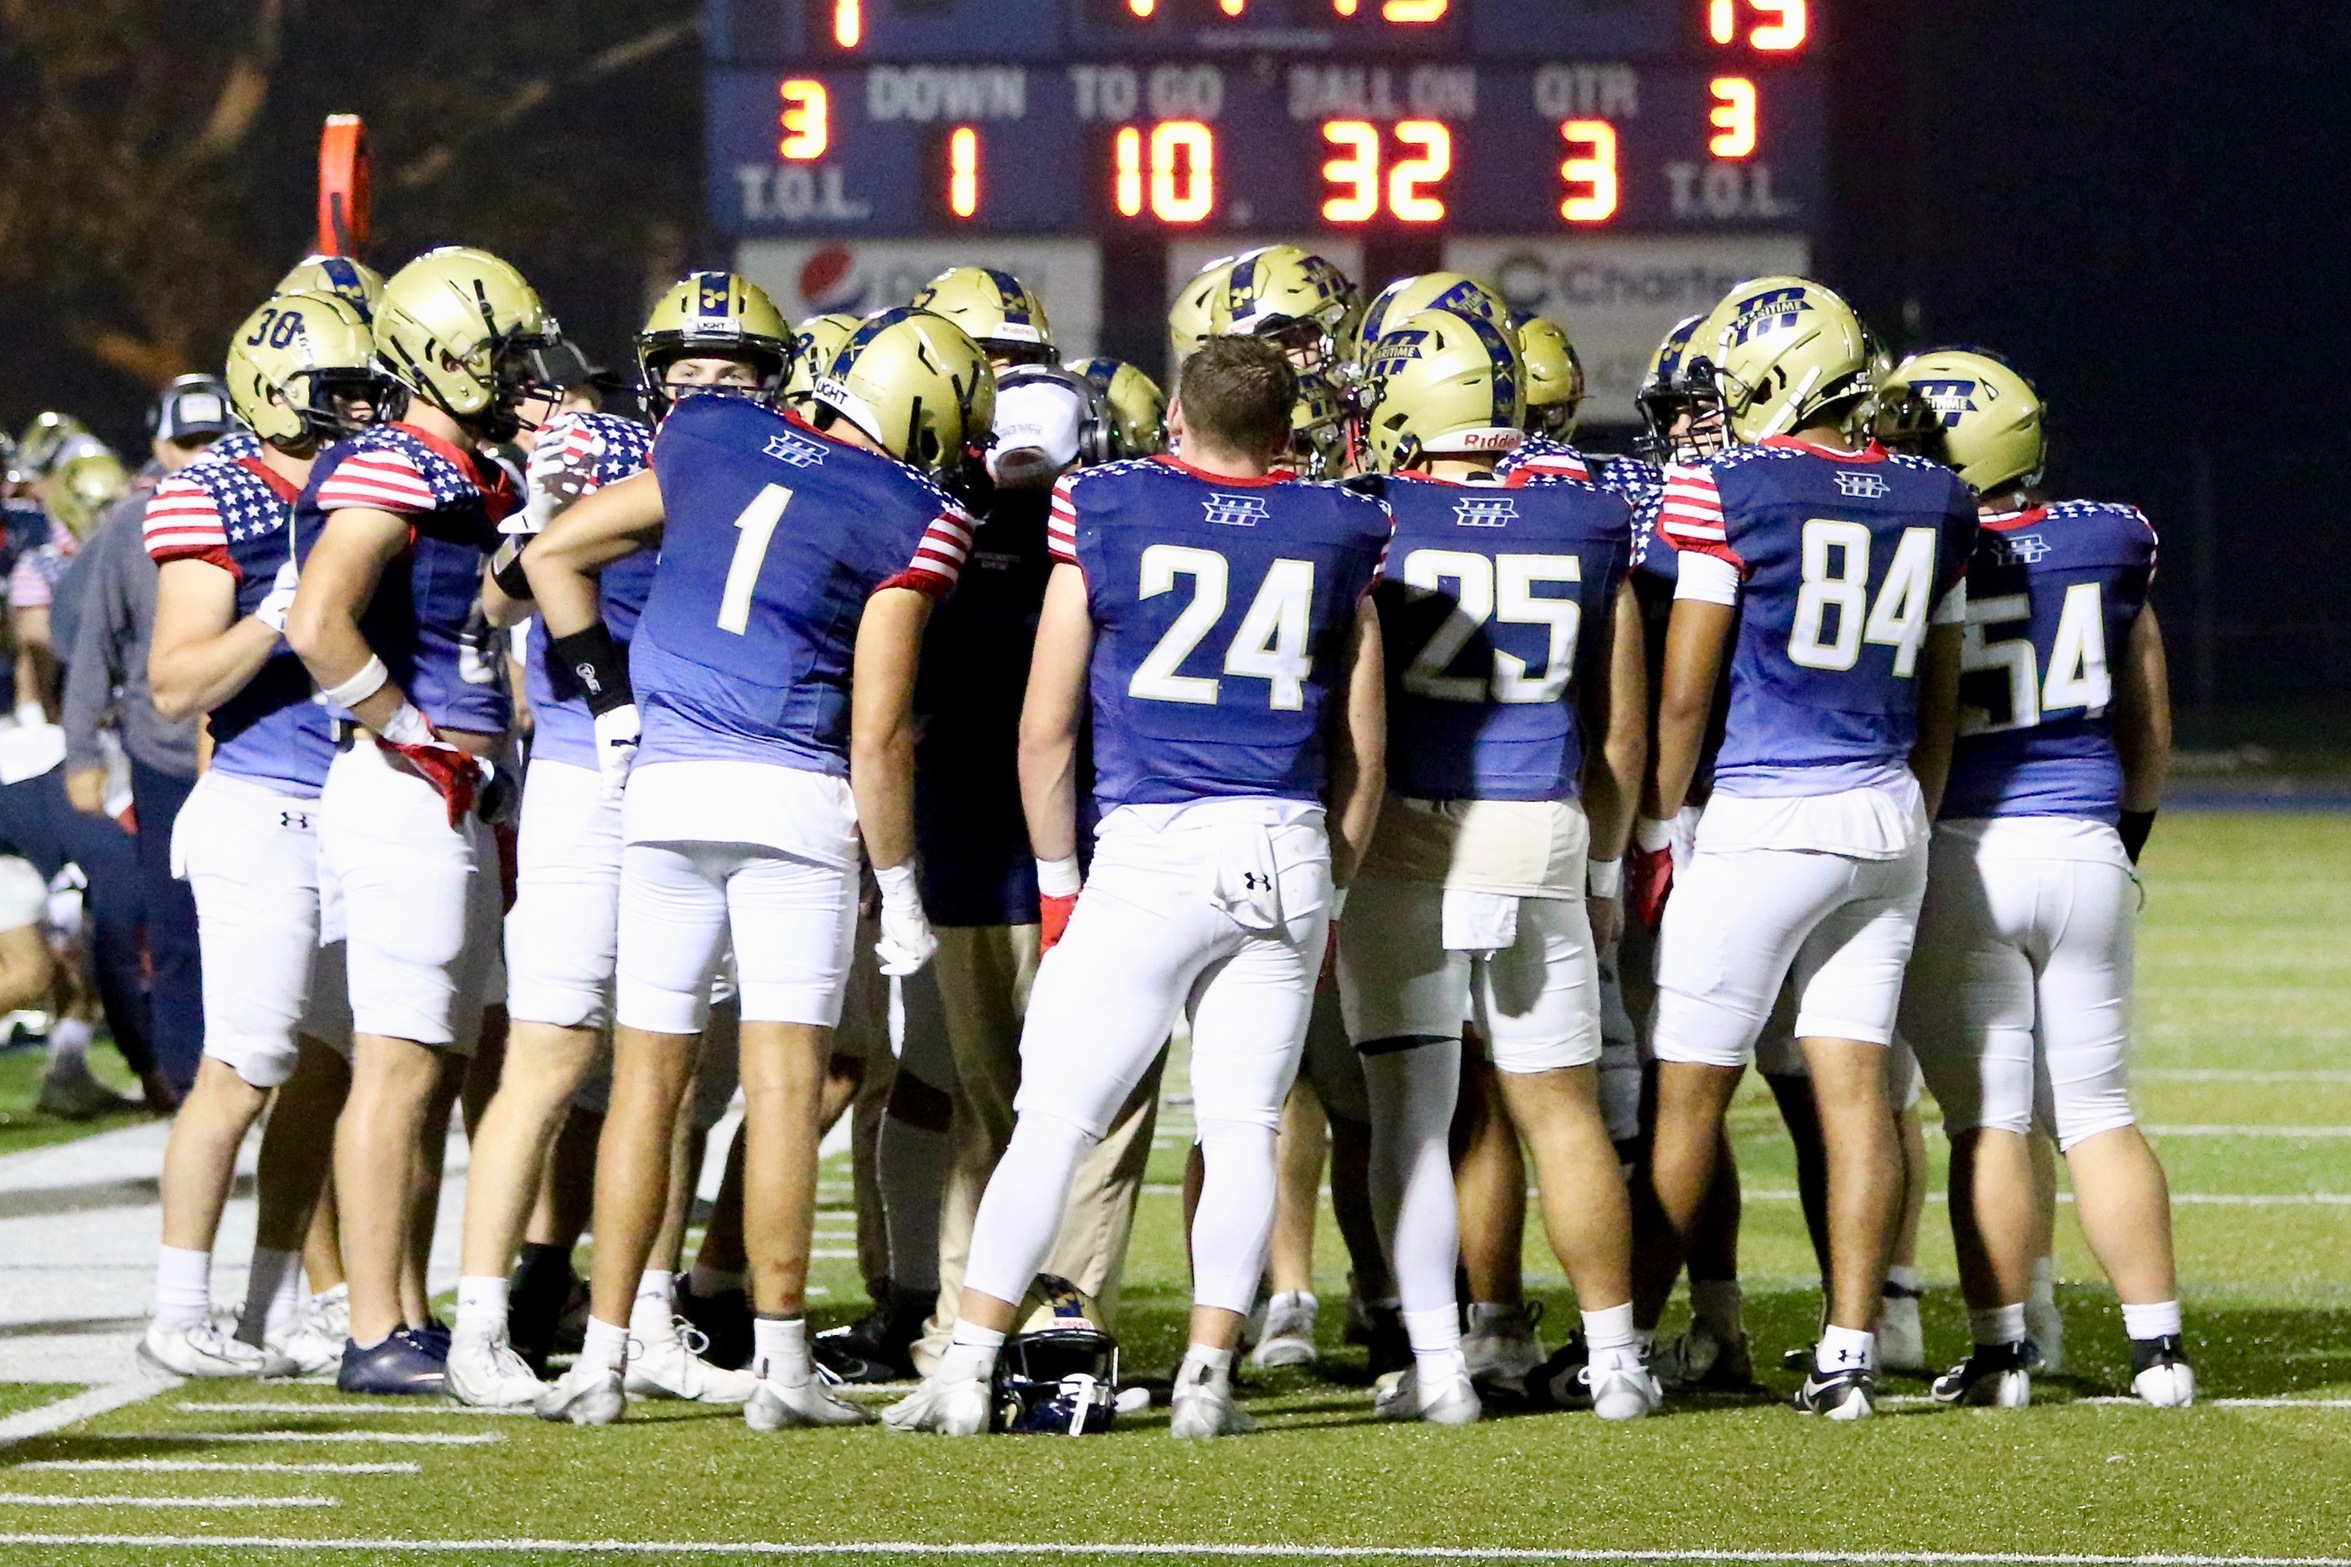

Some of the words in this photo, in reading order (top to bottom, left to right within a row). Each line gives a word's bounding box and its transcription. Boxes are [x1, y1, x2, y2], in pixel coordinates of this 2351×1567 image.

[780, 79, 827, 159] 3
[866, 64, 1027, 120] DOWN
[1068, 65, 1138, 119] TO
[1148, 65, 1225, 119] GO
[1288, 65, 1394, 120] BALL
[1409, 64, 1476, 119] ON
[1533, 63, 1640, 119] QTR
[1709, 76, 1756, 157] 3
[951, 127, 977, 217] 1
[1116, 121, 1213, 222] 10
[1323, 120, 1450, 221] 32
[1561, 120, 1617, 221] 3
[717, 482, 794, 636] 1
[1787, 518, 1936, 678] 84
[1128, 543, 1316, 712] 24
[1403, 548, 1582, 704] 25
[1958, 581, 2112, 737] 54
